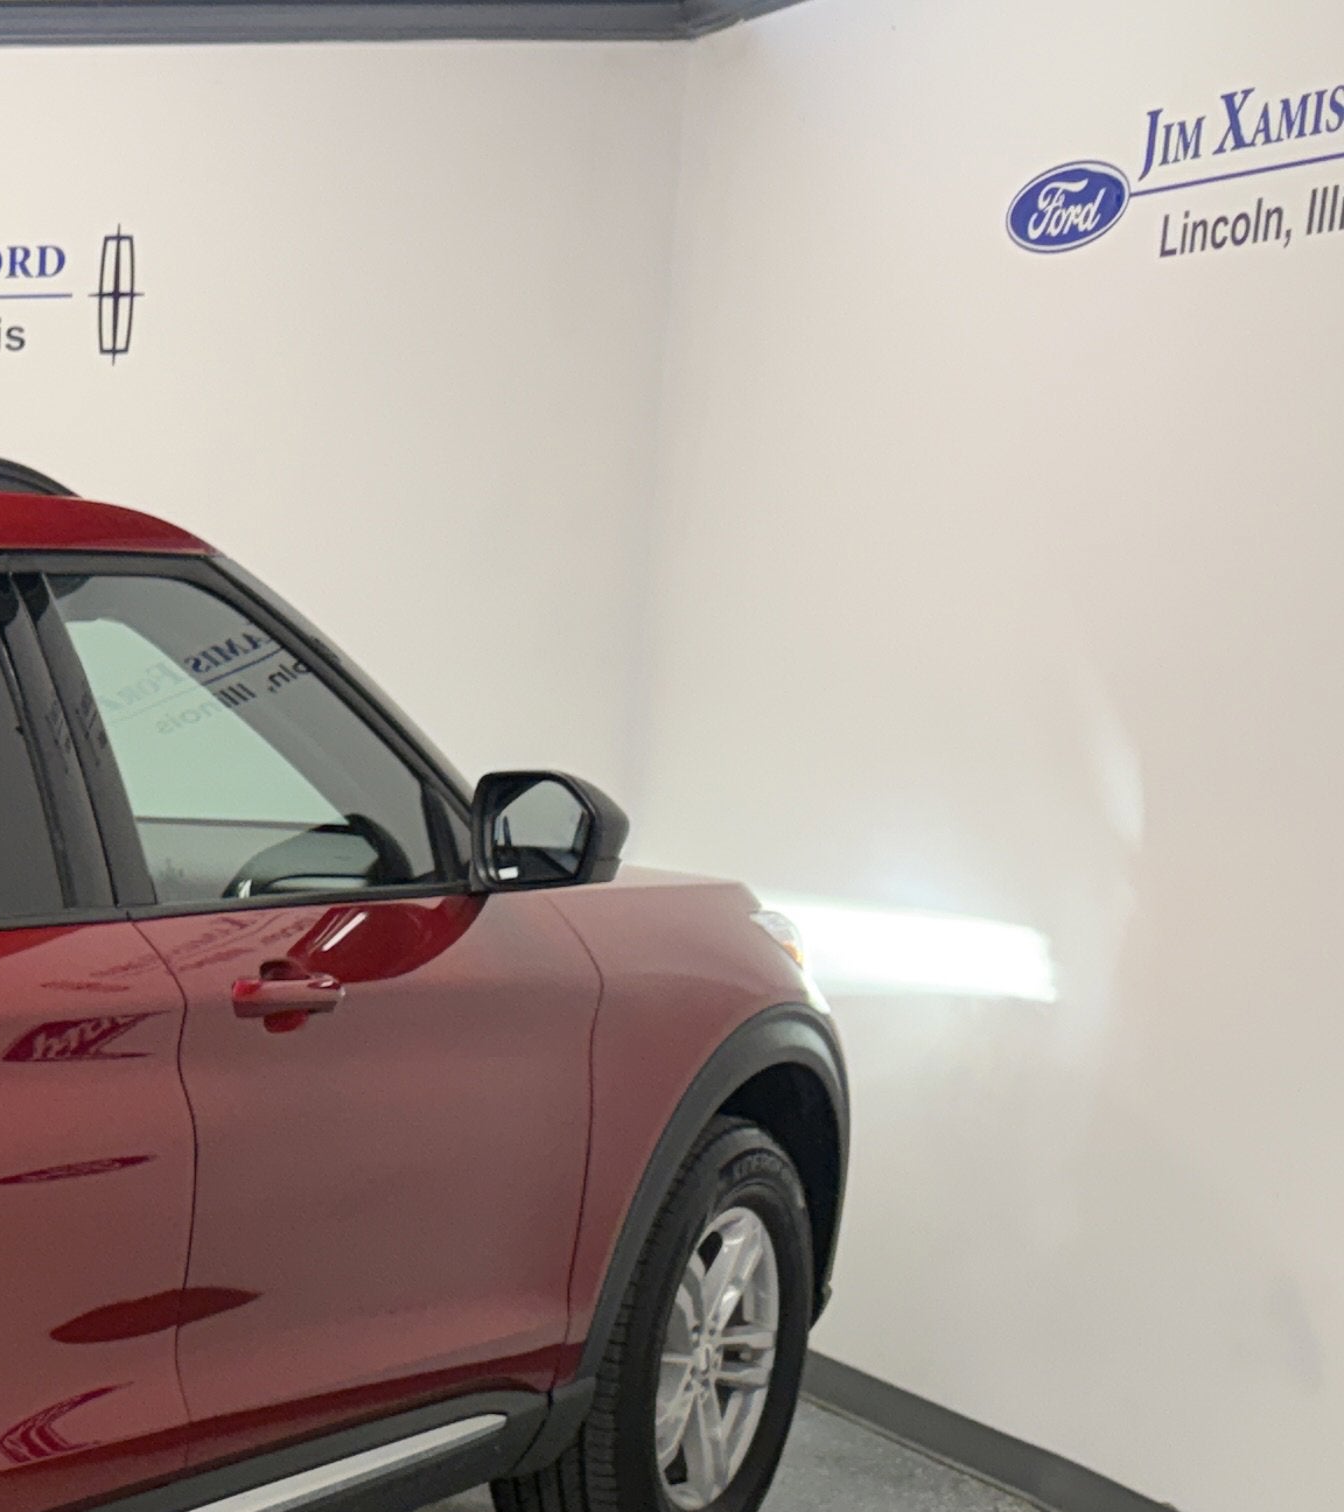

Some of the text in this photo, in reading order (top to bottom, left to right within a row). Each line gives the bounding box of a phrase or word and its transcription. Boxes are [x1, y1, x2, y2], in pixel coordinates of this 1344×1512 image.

[1138, 108, 1205, 181] JIM
[1028, 178, 1106, 240] Ford
[1160, 197, 1292, 258] Lincoln,
